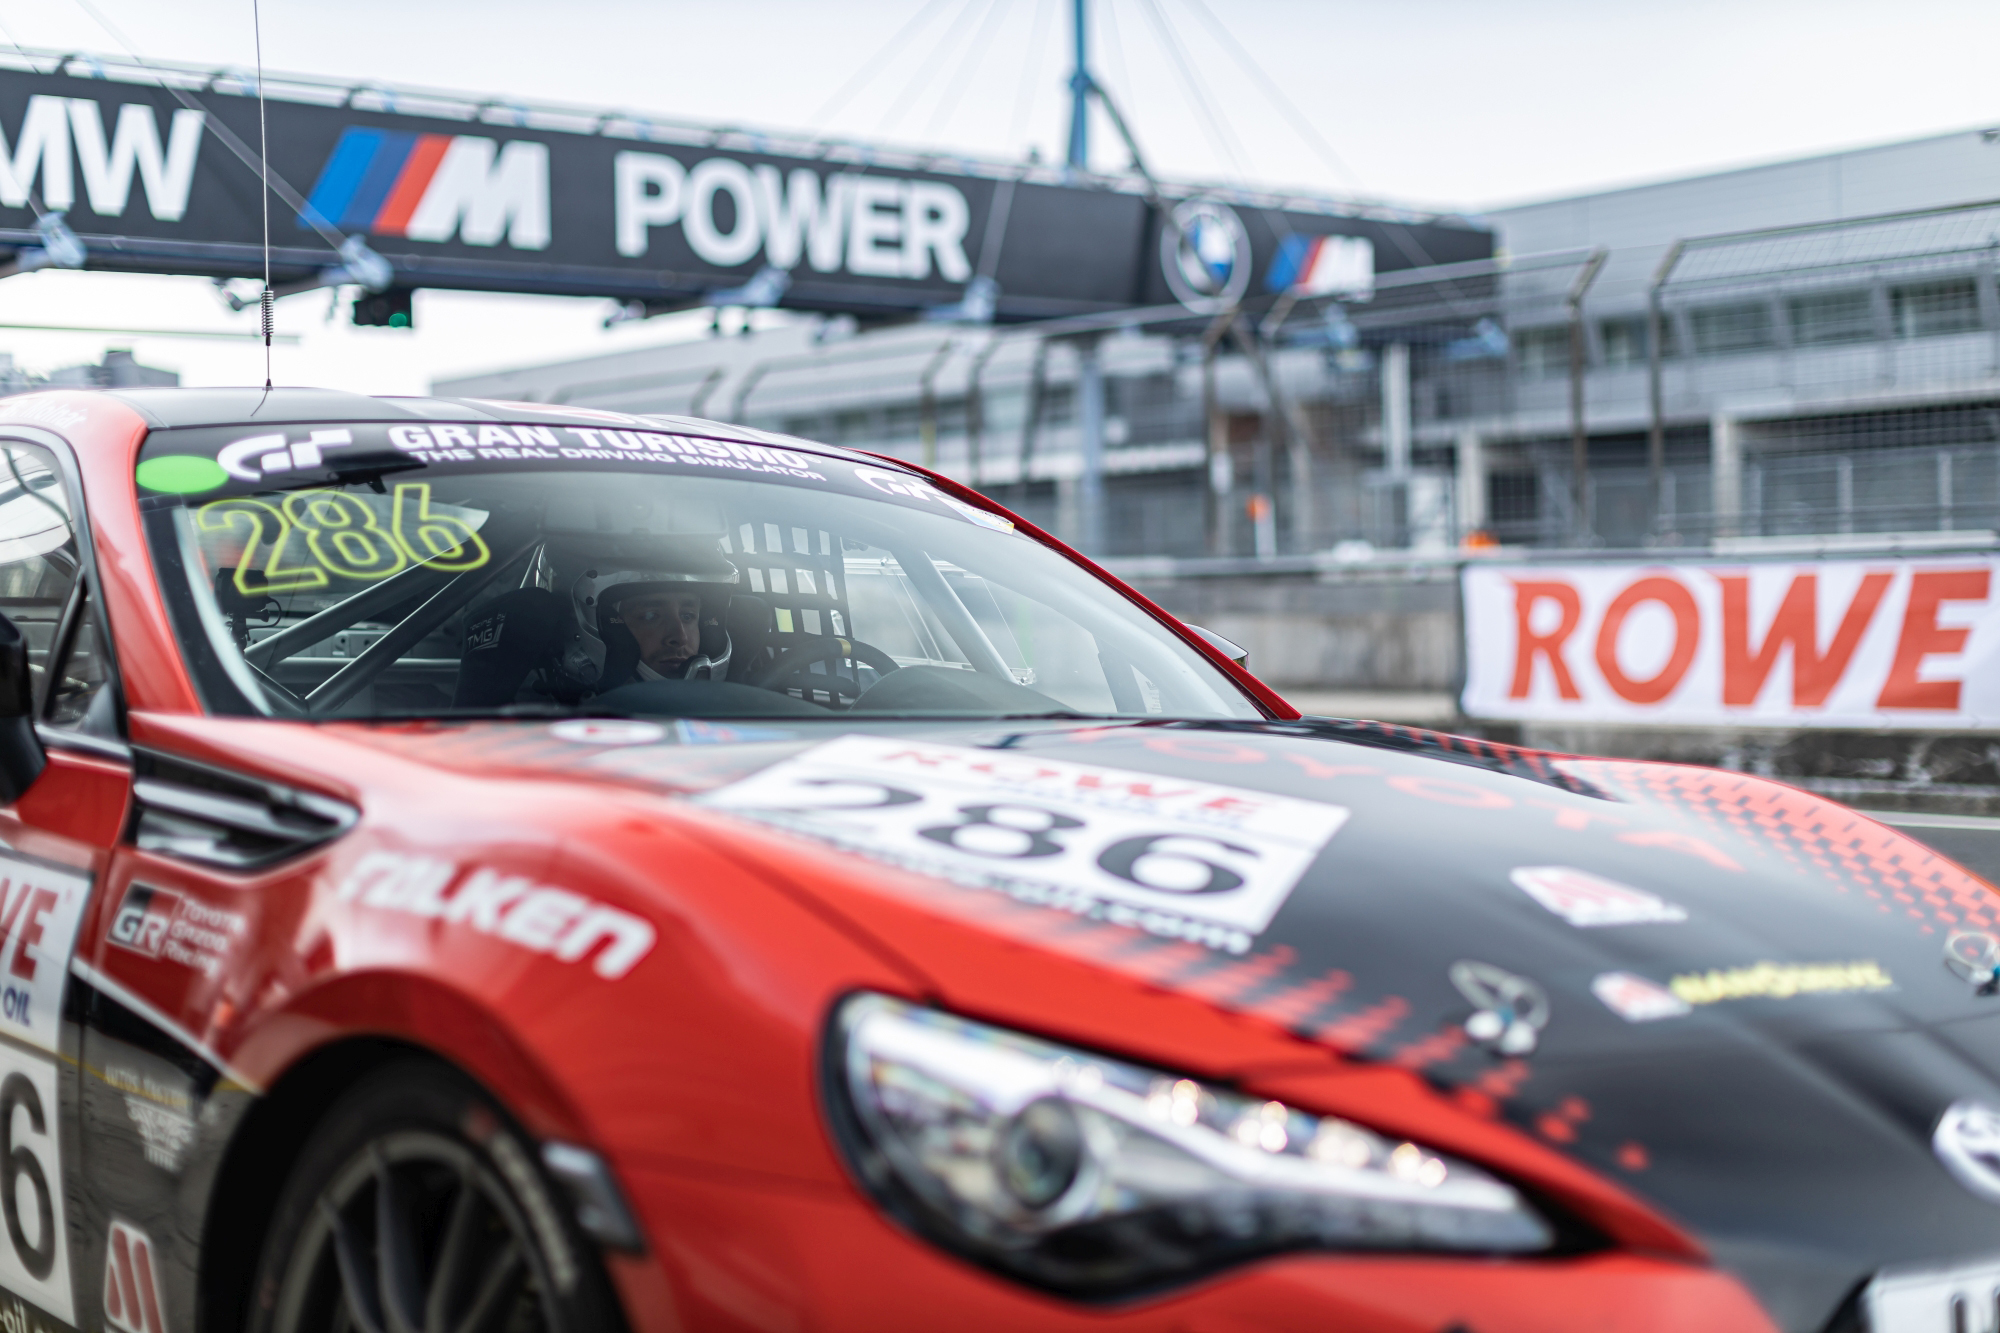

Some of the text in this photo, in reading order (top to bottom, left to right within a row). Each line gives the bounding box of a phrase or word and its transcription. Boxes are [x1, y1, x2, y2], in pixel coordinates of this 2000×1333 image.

[614, 148, 974, 283] POWER
[388, 424, 560, 450] GRAN
[564, 426, 810, 470] TURISMO
[408, 447, 827, 482] THE REAL DRIVING SIMULATOR
[196, 483, 491, 595] 286
[467, 628, 493, 648] TMG
[1503, 568, 1991, 713] ROWE
[112, 907, 169, 951] GR
[337, 850, 658, 981] FALKEN
